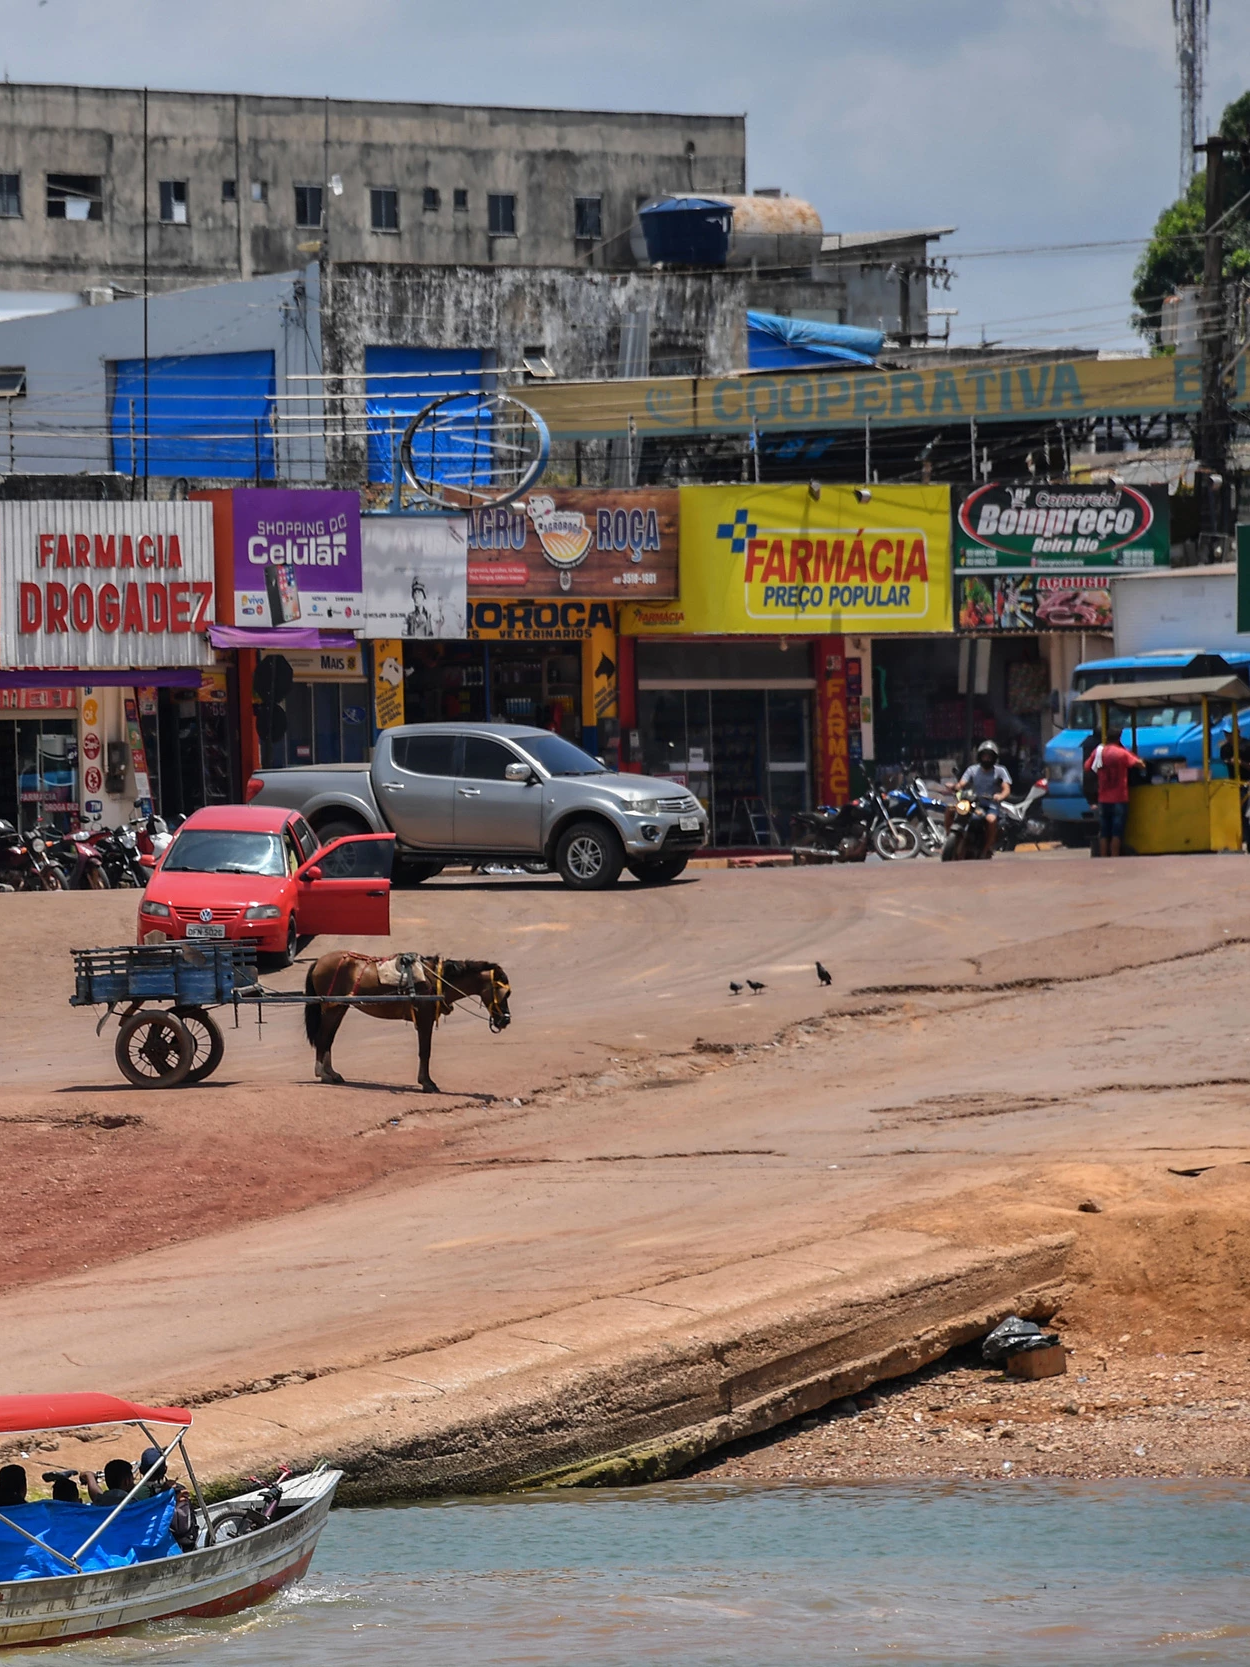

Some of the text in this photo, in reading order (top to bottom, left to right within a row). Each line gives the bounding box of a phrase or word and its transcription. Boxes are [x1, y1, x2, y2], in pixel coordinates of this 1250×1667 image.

[711, 363, 1083, 422] COOPERATIVA
[257, 513, 348, 536] SHOPPING DO
[596, 507, 661, 563] ROÇA
[976, 503, 1135, 540] Bompreço
[38, 534, 183, 569] FARMACIA
[744, 527, 929, 584] FARMÁCIA
[1031, 537, 1100, 553] Beira Rio
[763, 585, 911, 614] PREÇO POPULAR
[1036, 577, 1111, 592] AÇOUGU
[18, 582, 214, 634] DROGADEZ
[320, 656, 345, 670] MAIS
[826, 678, 850, 806] FARMACI
